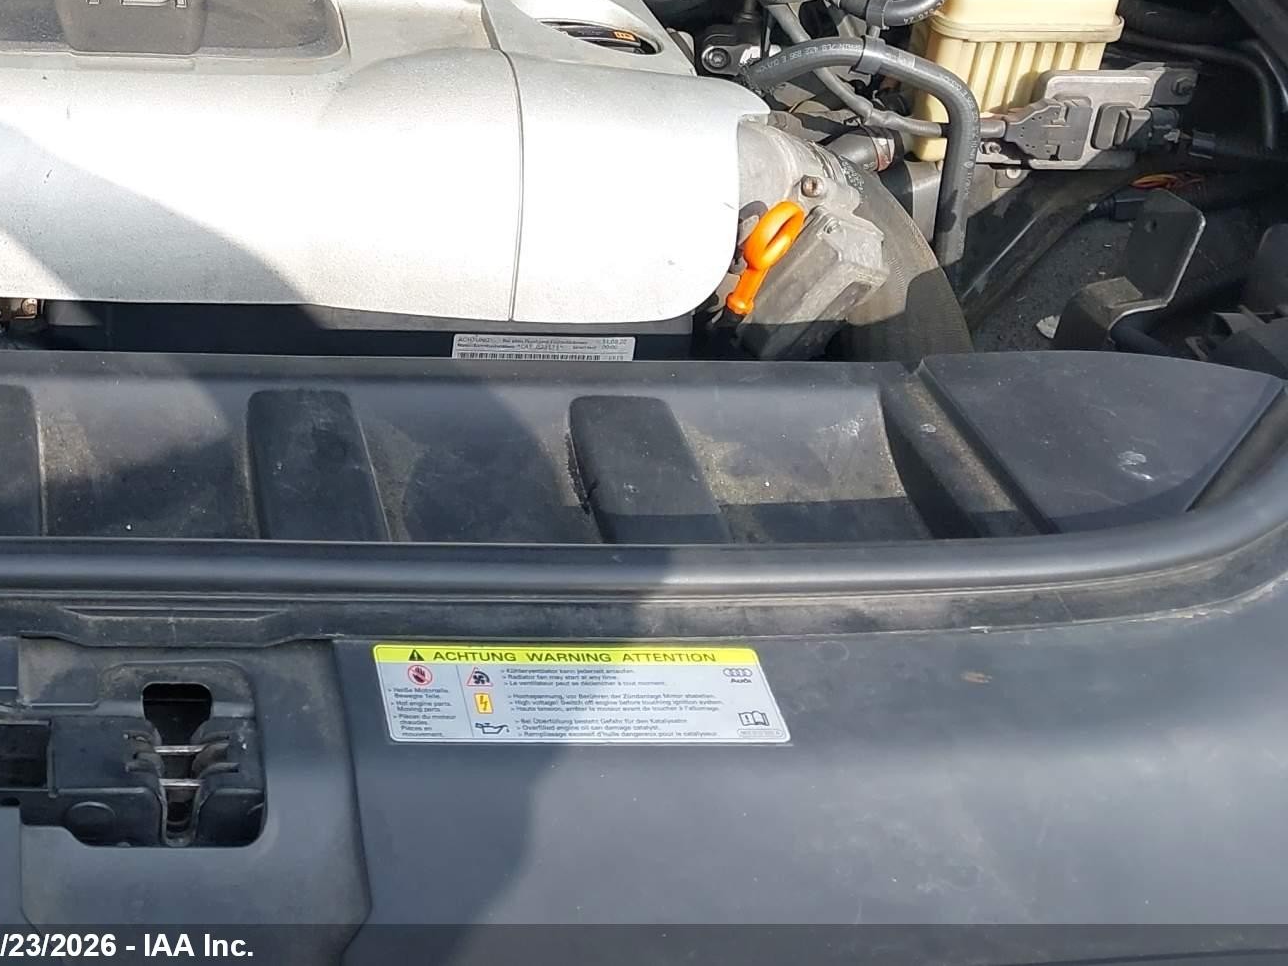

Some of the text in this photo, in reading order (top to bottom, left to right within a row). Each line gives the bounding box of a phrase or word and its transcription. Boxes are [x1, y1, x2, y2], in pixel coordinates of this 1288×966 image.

[433, 651, 717, 663] ACHTUNG WARNING ATTENTION
